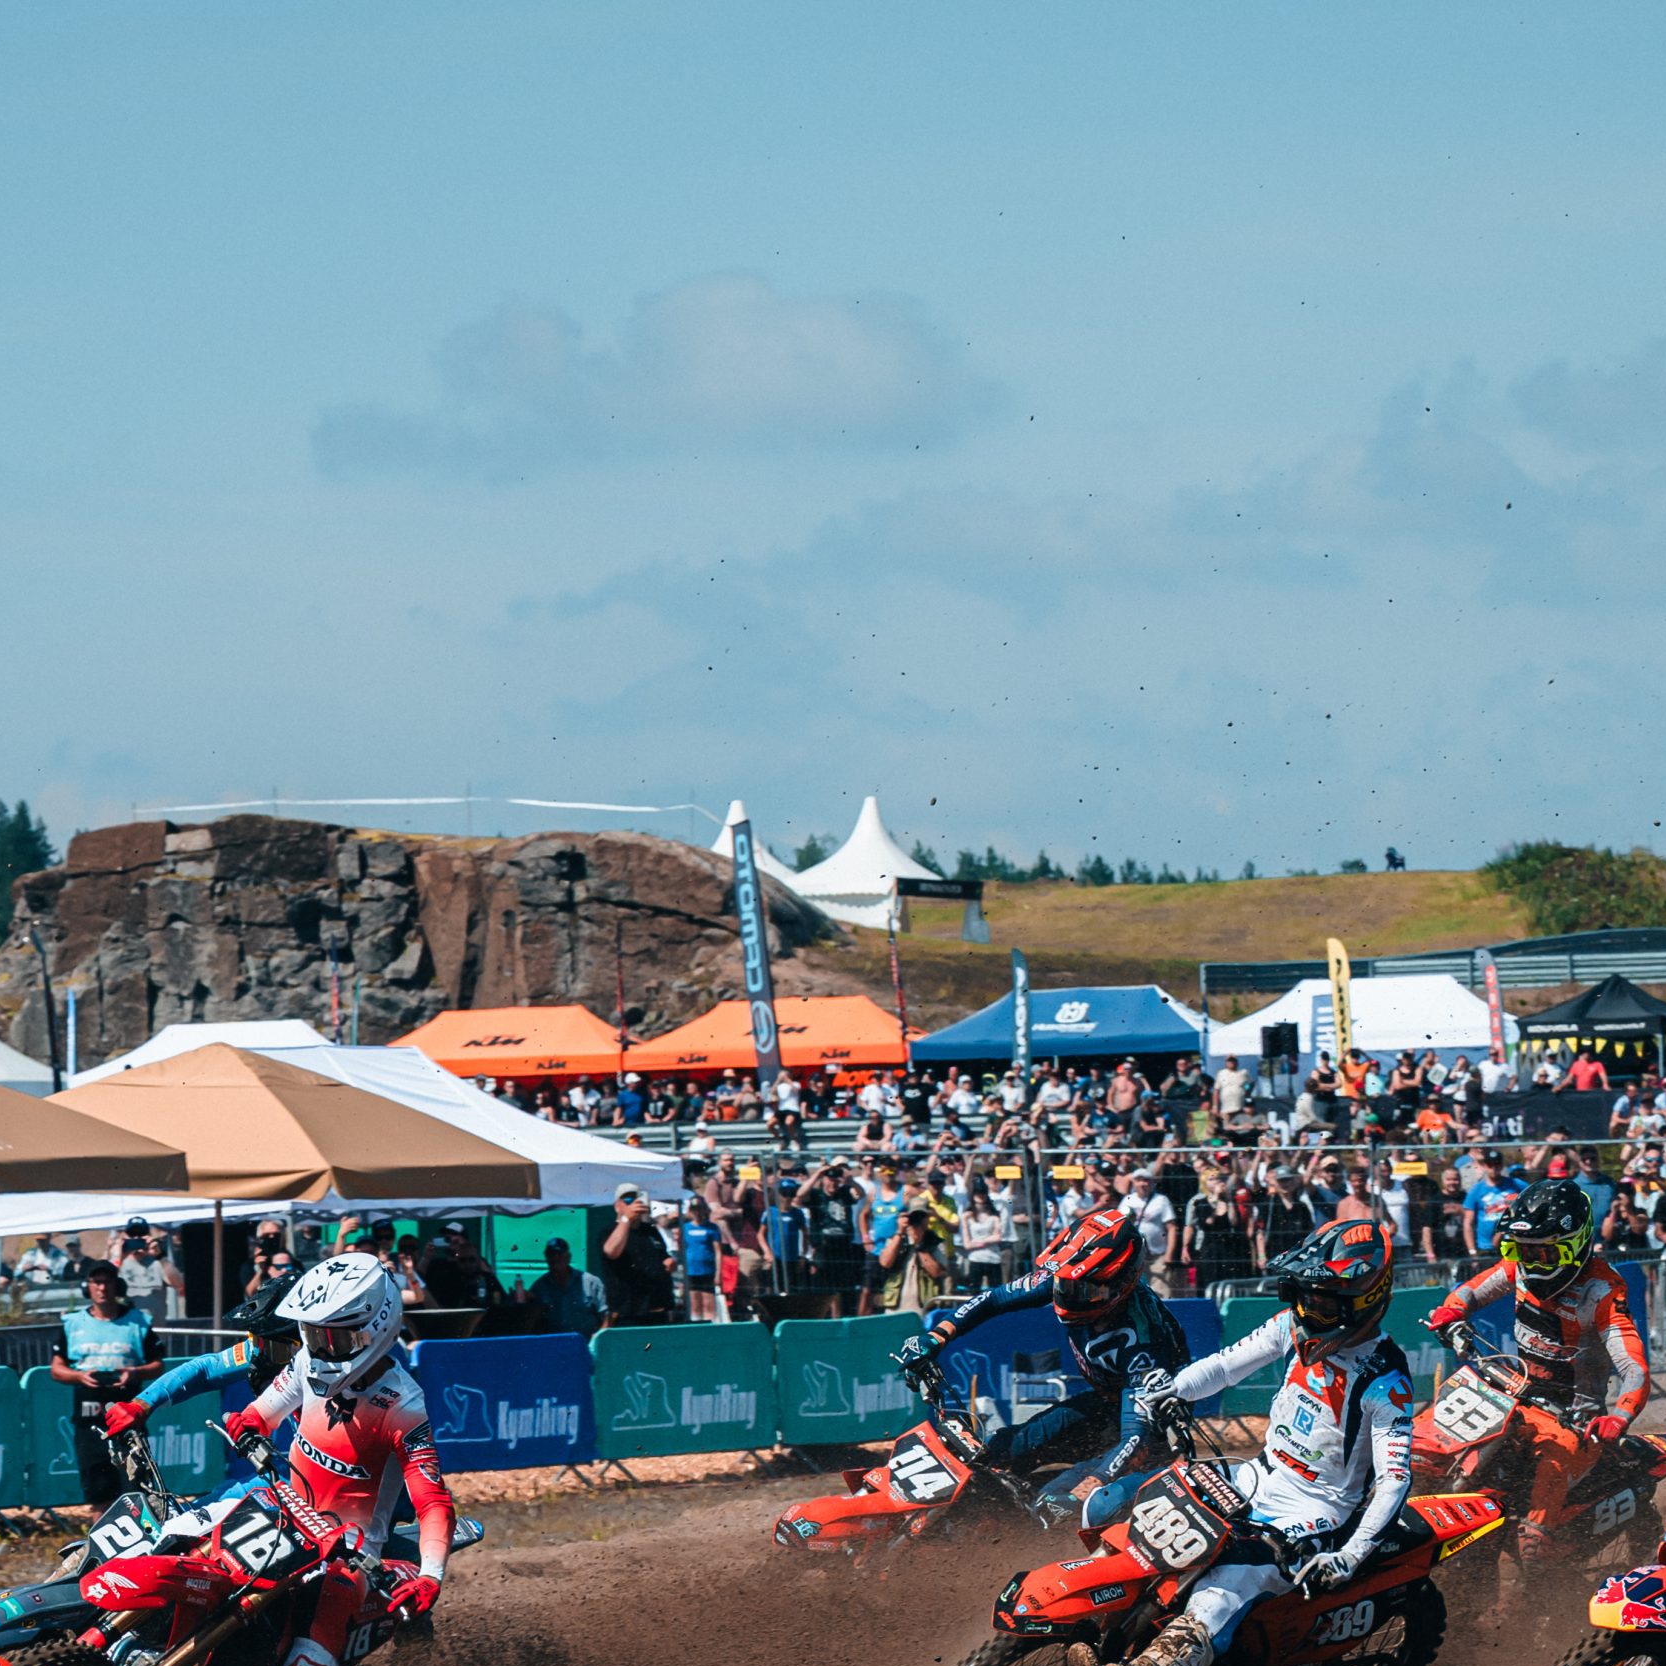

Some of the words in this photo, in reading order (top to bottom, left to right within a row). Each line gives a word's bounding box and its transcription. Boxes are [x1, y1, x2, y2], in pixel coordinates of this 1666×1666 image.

[462, 1036, 526, 1047] KTM
[677, 1054, 708, 1064] KTM
[820, 1049, 851, 1059] KTM
[537, 1060, 567, 1069] KTM
[372, 1297, 393, 1332] FOX
[1433, 1386, 1505, 1443] 83
[295, 1432, 371, 1480] HONDA
[888, 1444, 956, 1499] 114
[1192, 1469, 1233, 1513] RENTHAL
[1198, 1463, 1242, 1509] RENTHAL
[279, 1483, 334, 1534] RENTHAL
[1593, 1488, 1636, 1535] 83
[223, 1512, 294, 1575] 18
[1133, 1496, 1207, 1569] 489
[1126, 1545, 1151, 1570] MOTUL
[1094, 1586, 1124, 1604] AIROH
[343, 1622, 372, 1661] 18
